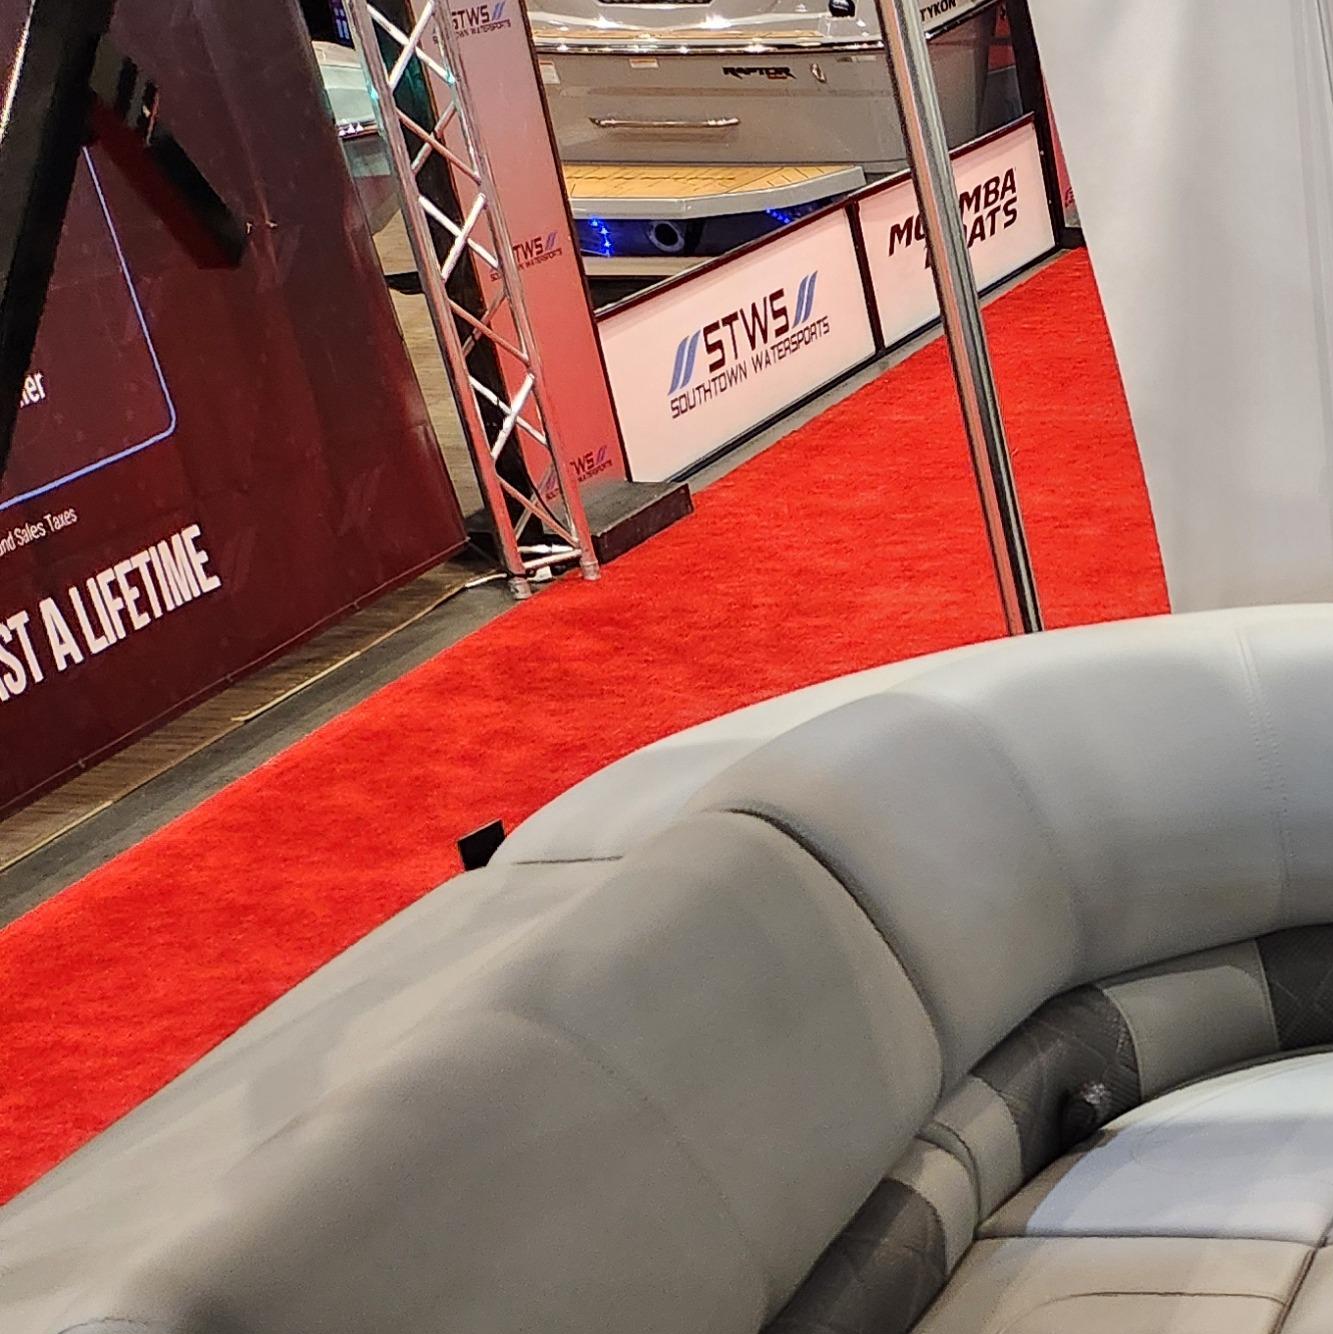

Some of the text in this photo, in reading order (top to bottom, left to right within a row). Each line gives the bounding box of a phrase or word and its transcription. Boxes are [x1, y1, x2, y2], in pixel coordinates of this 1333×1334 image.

[722, 66, 796, 80] RAPTOR
[512, 236, 543, 262] TWS
[889, 168, 1017, 257] MOMBA
[670, 315, 830, 419] SOUTHTOWN WATERSPORTS
[703, 288, 789, 373] STWS
[14, 520, 46, 546] Sales
[44, 507, 78, 533] Taxes
[0, 524, 222, 701] ST A LIFETIME
